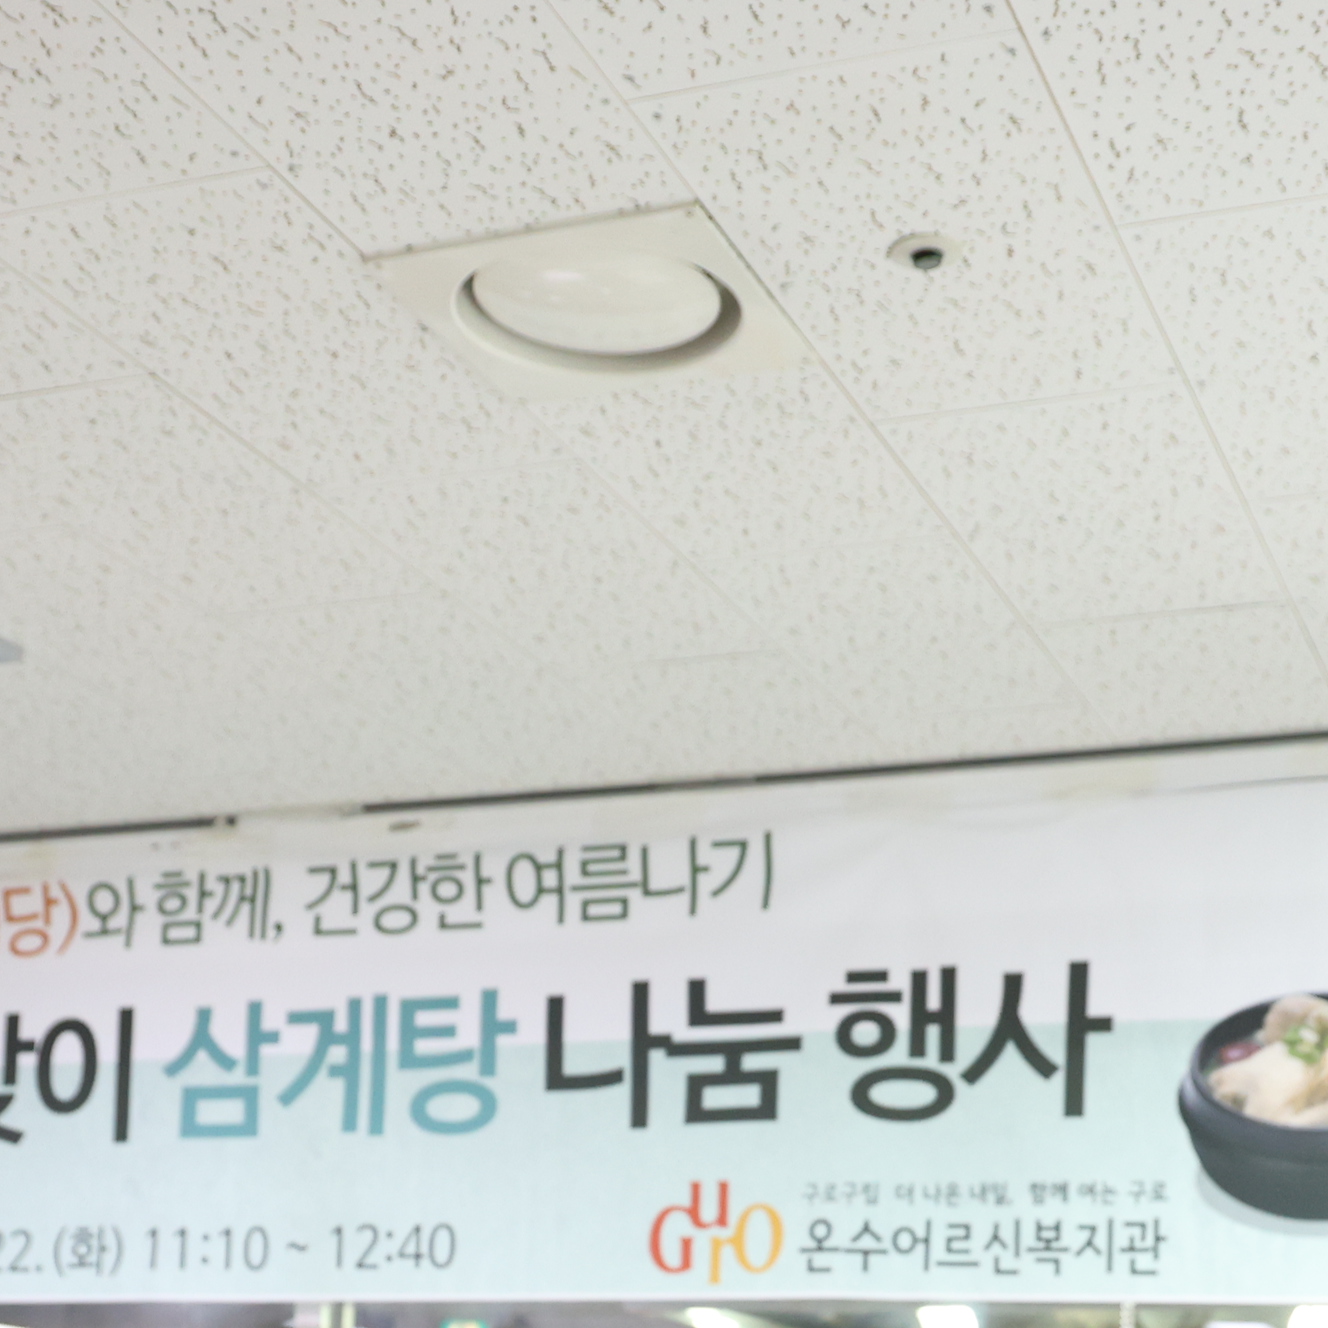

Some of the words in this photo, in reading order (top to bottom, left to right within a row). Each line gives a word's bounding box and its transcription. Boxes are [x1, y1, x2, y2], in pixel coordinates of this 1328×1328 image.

[154, 867, 284, 945] 함께,
[305, 851, 493, 936] 건강한
[504, 830, 775, 926] 여름나기
[161, 989, 518, 1138] 삼계탕
[543, 977, 803, 1130] 나눔
[827, 959, 1114, 1124] 행사
[894, 1182, 915, 1205] 더
[922, 1182, 961, 1207] 나은
[1028, 1181, 1069, 1206] 함께
[1076, 1182, 1117, 1206] 여는
[1127, 1180, 1169, 1206] 구로
[146, 1225, 270, 1272] 11:10
[330, 1222, 457, 1270] 12:40
[798, 1217, 1167, 1276] 온수어르신복지관
